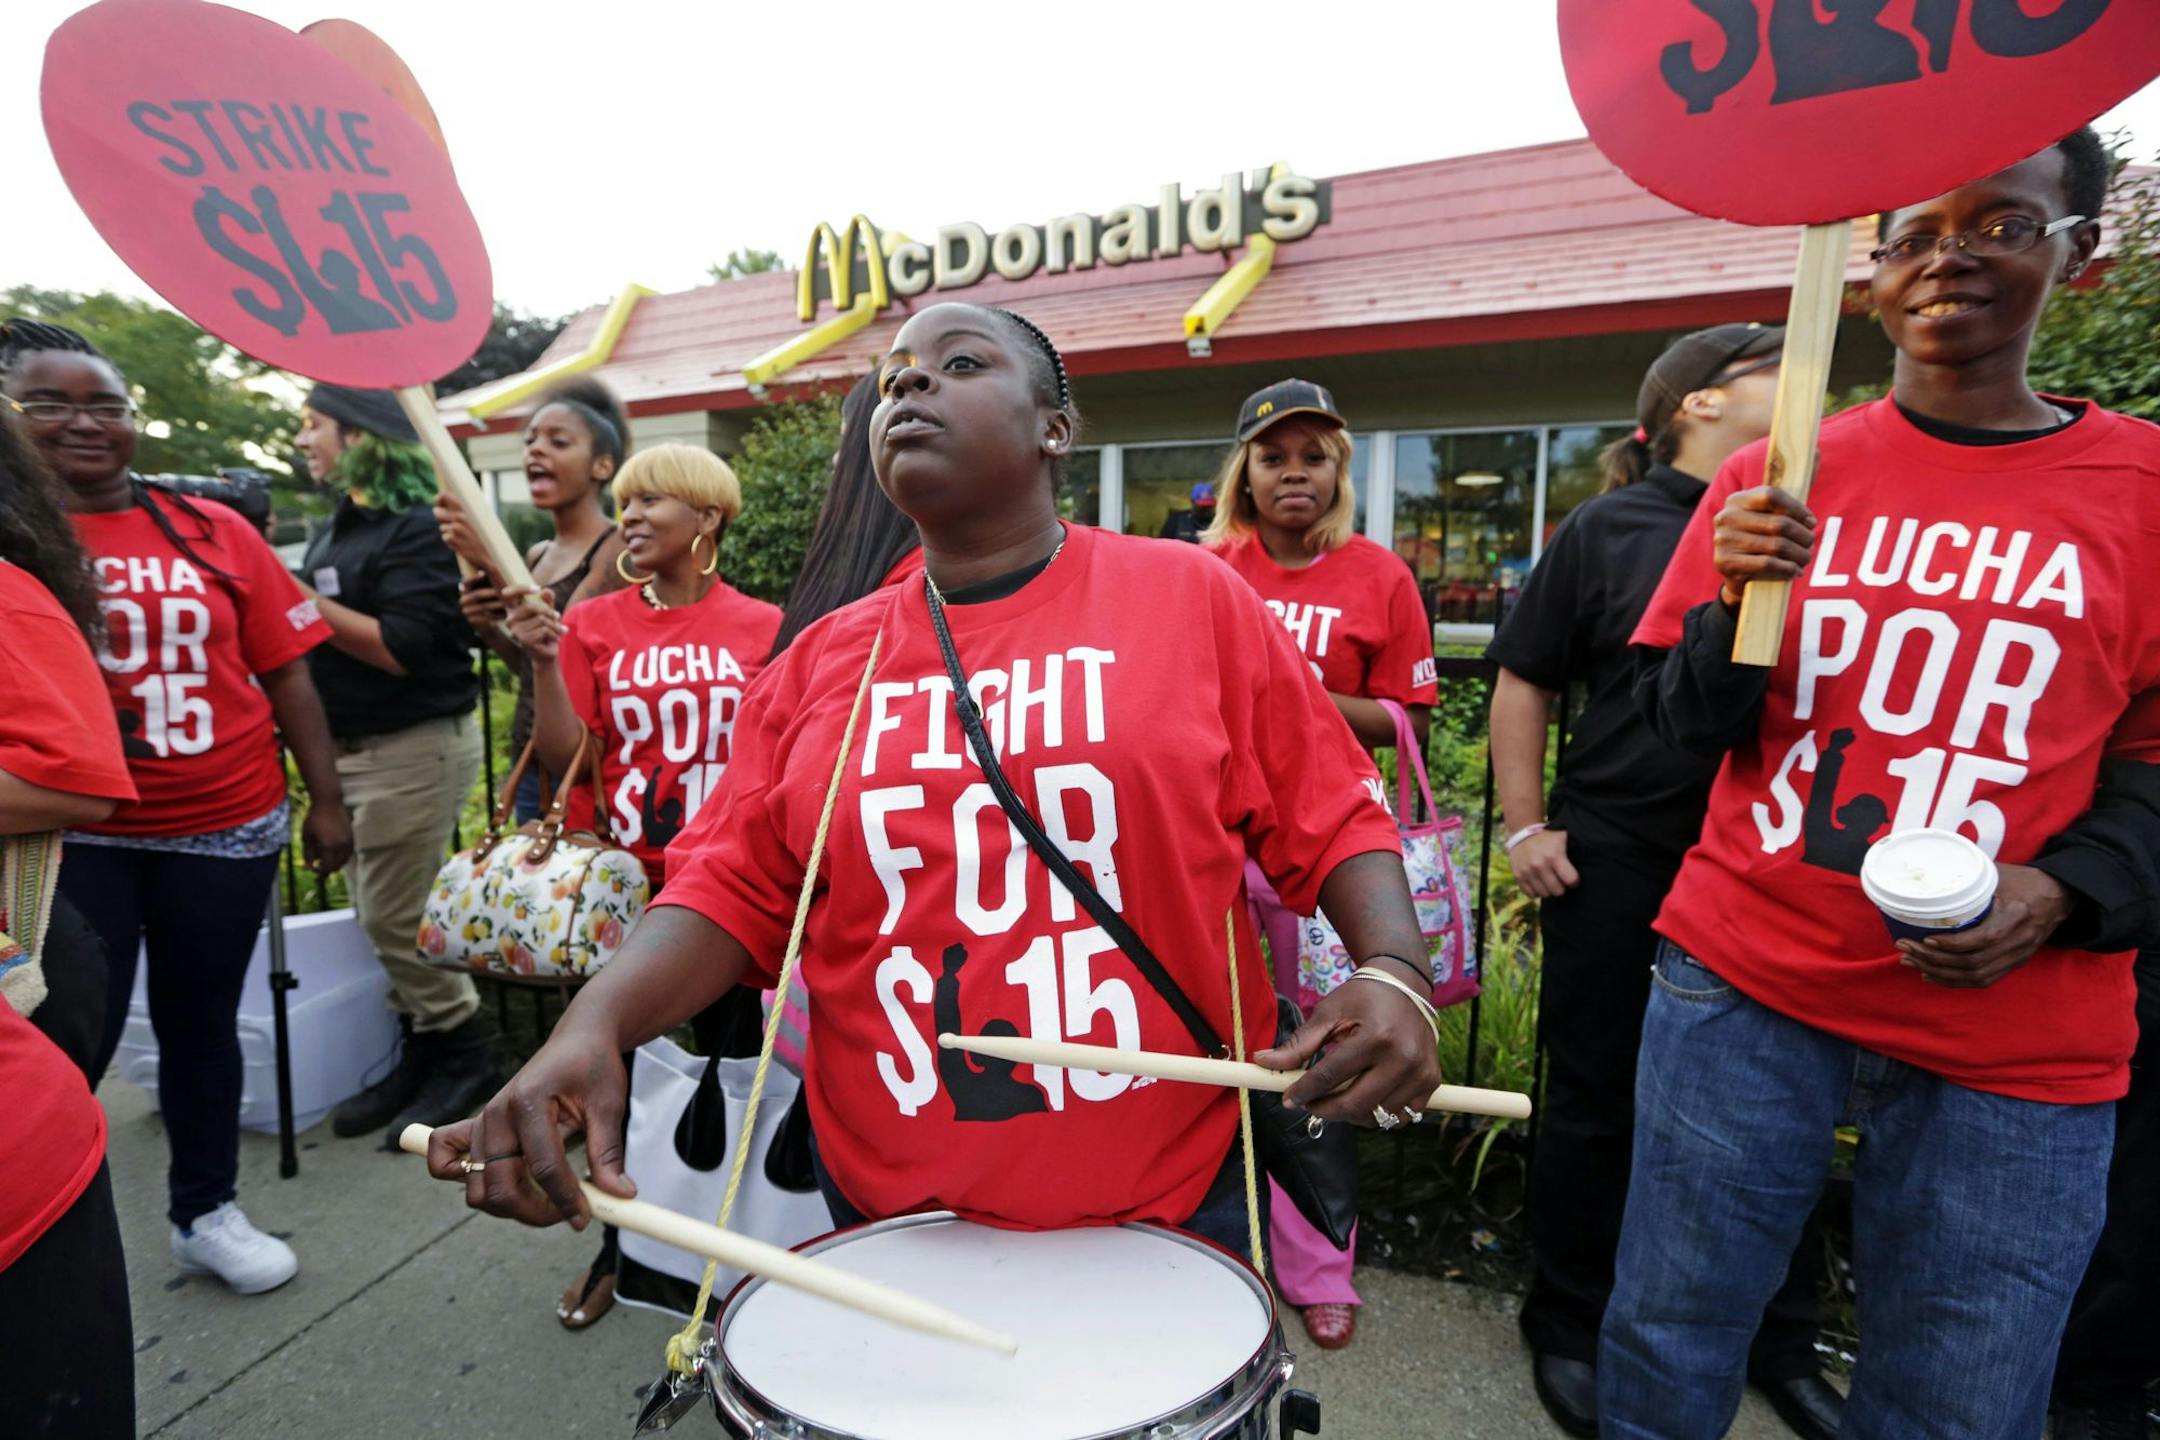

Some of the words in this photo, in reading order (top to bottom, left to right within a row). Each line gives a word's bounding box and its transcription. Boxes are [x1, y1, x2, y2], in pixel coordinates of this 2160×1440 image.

[127, 100, 390, 178] STRIKE
[797, 165, 1319, 321] McDonald's
[90, 556, 207, 594] CHA
[1809, 516, 2084, 619] LUCHA
[608, 644, 746, 690] LUCHA
[861, 647, 1115, 777] FIGHT
[1793, 599, 2061, 761] POR
[610, 686, 743, 765] POR
[610, 763, 728, 847] $1
[860, 763, 1123, 936] FOR
